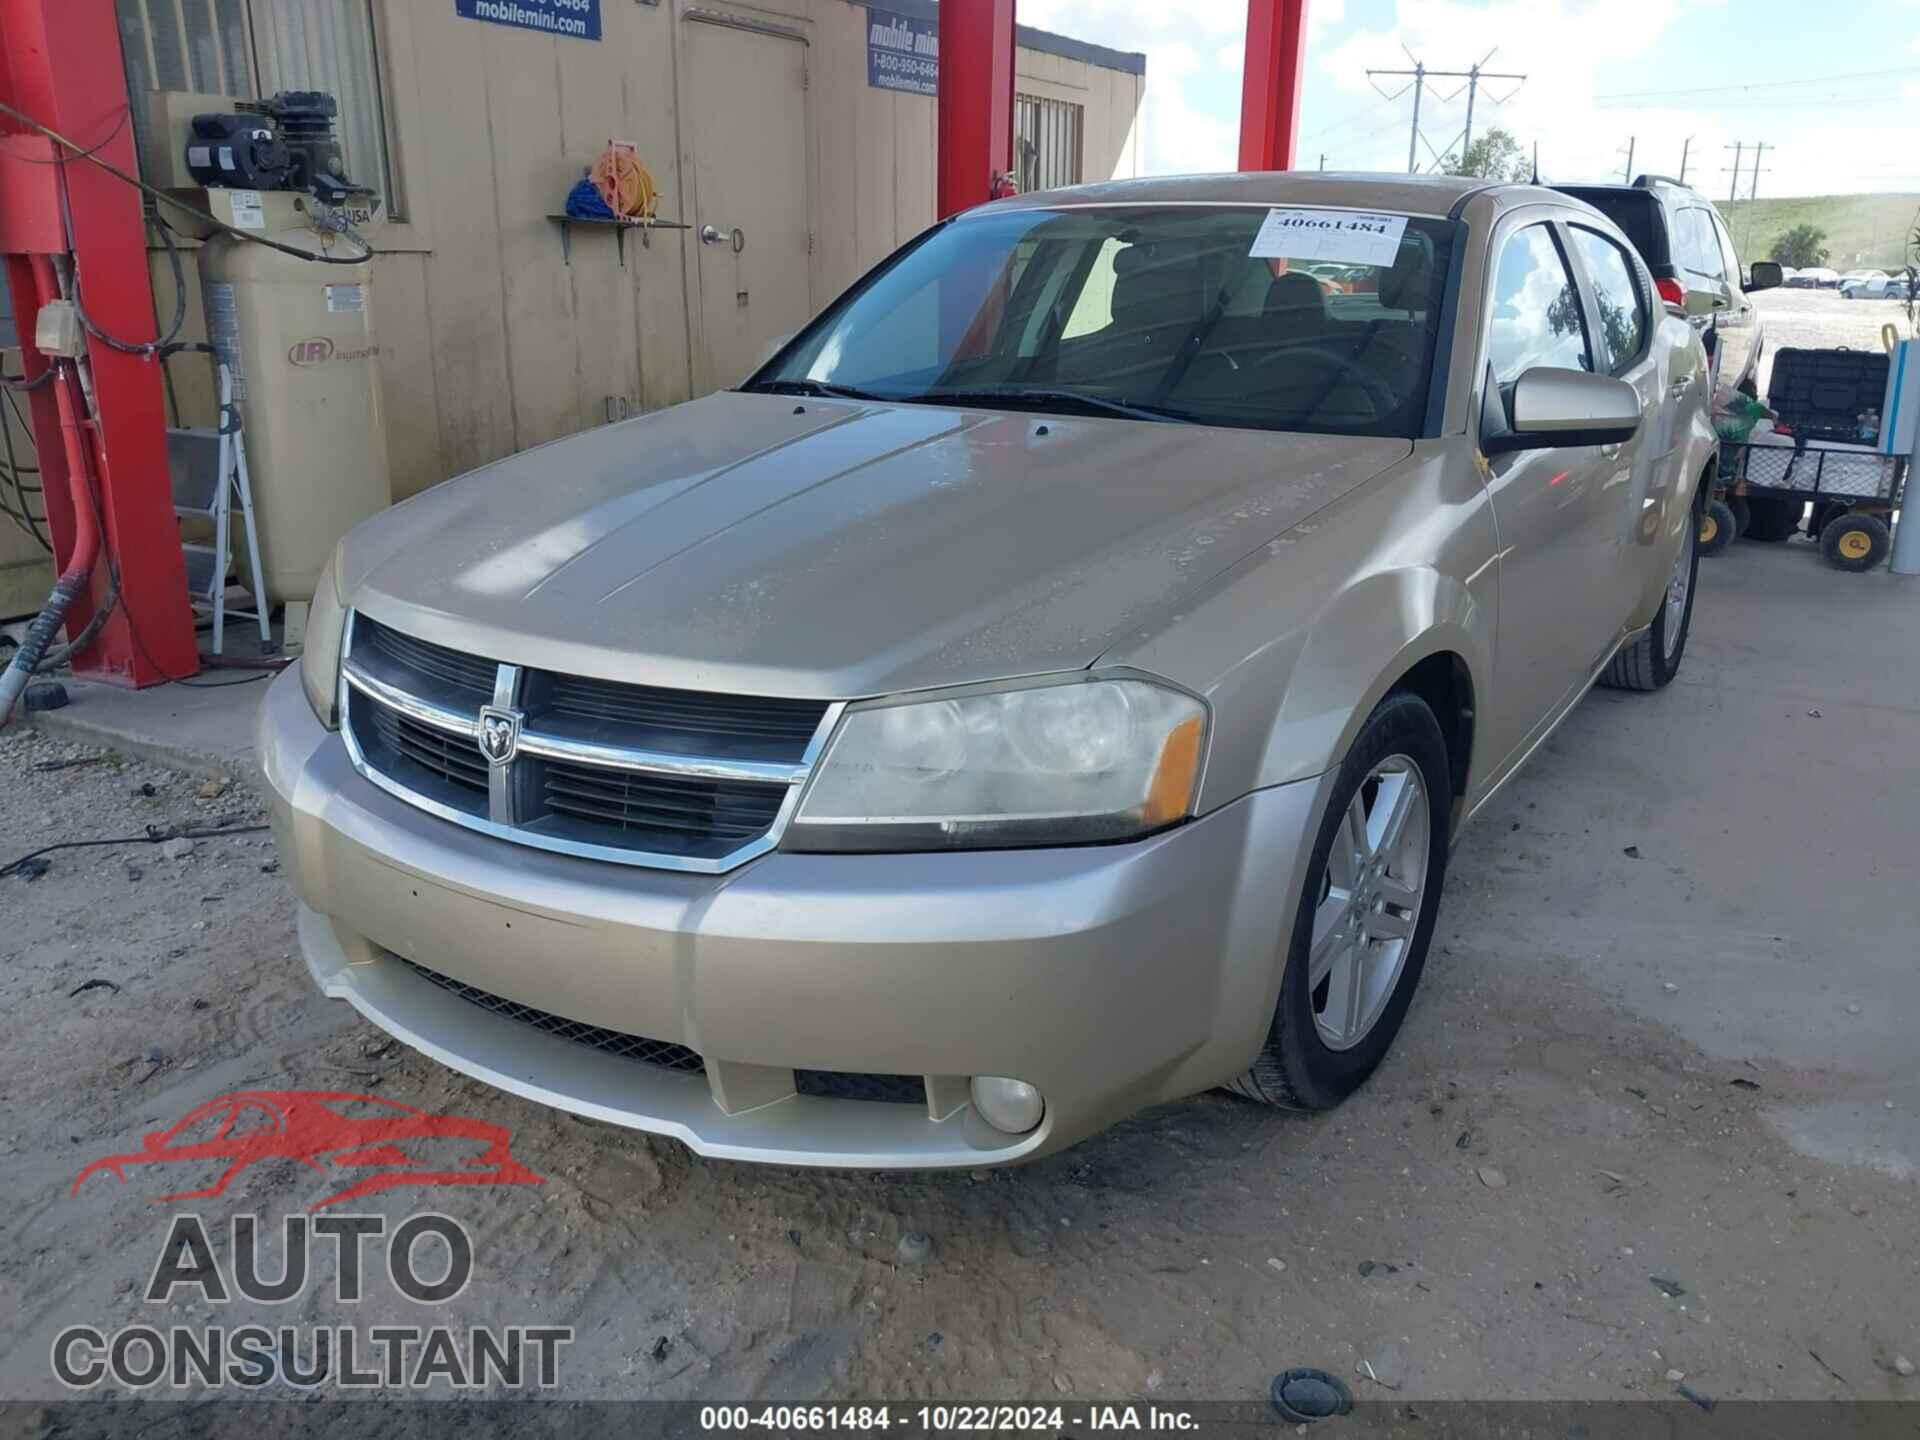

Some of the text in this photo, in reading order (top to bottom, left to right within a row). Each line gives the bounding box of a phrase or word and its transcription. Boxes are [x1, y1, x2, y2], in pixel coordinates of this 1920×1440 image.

[475, 1, 586, 34] mobilemini.com
[870, 17, 914, 51] mobile
[1278, 218, 1386, 234] 40661484
